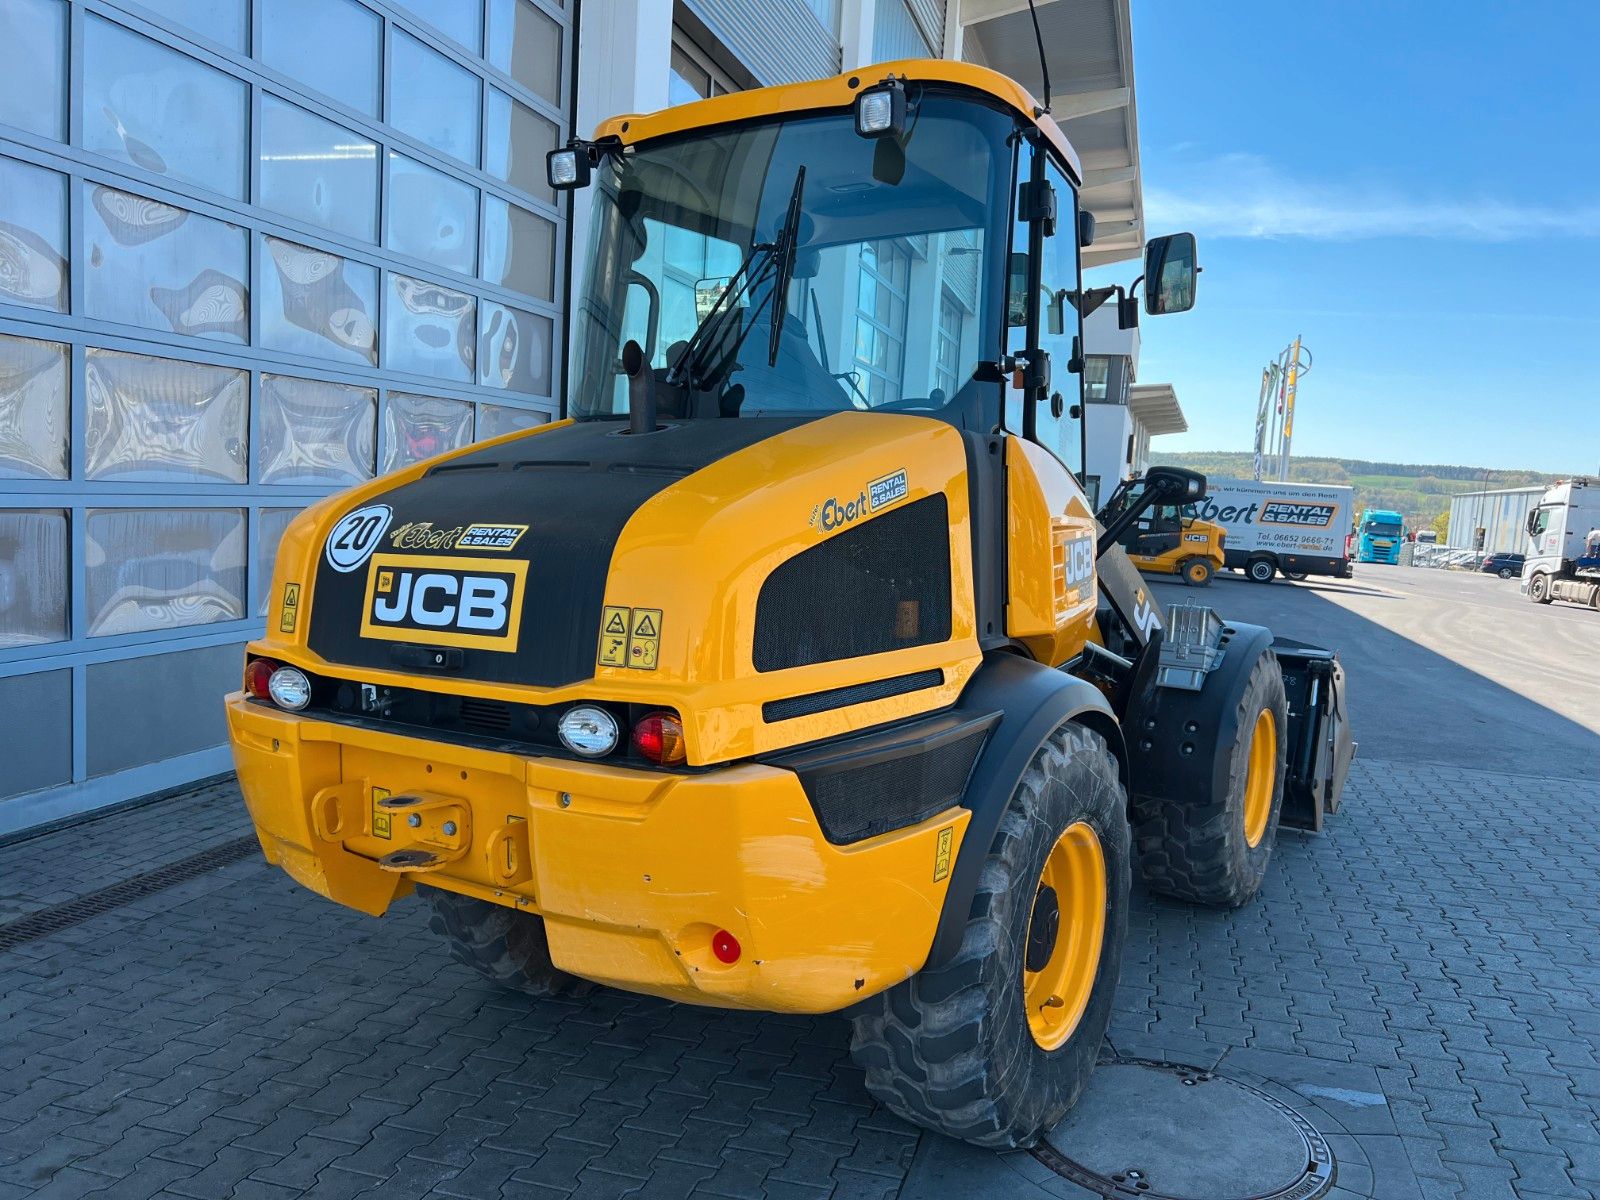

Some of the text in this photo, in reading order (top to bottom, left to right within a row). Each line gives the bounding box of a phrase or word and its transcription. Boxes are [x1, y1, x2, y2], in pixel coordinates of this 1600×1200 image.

[870, 475, 905, 496] RENTAL
[821, 491, 867, 531] Ebert
[1266, 503, 1332, 516] RENTAL
[334, 515, 382, 551] 20
[400, 522, 463, 549] Ebert
[467, 527, 518, 537] RENTAL
[1185, 534, 1208, 542] JCB
[1257, 532, 1271, 540] Tel.
[1273, 533, 1299, 542] 06652
[1065, 539, 1093, 584] JCB
[374, 572, 509, 630] JCB
